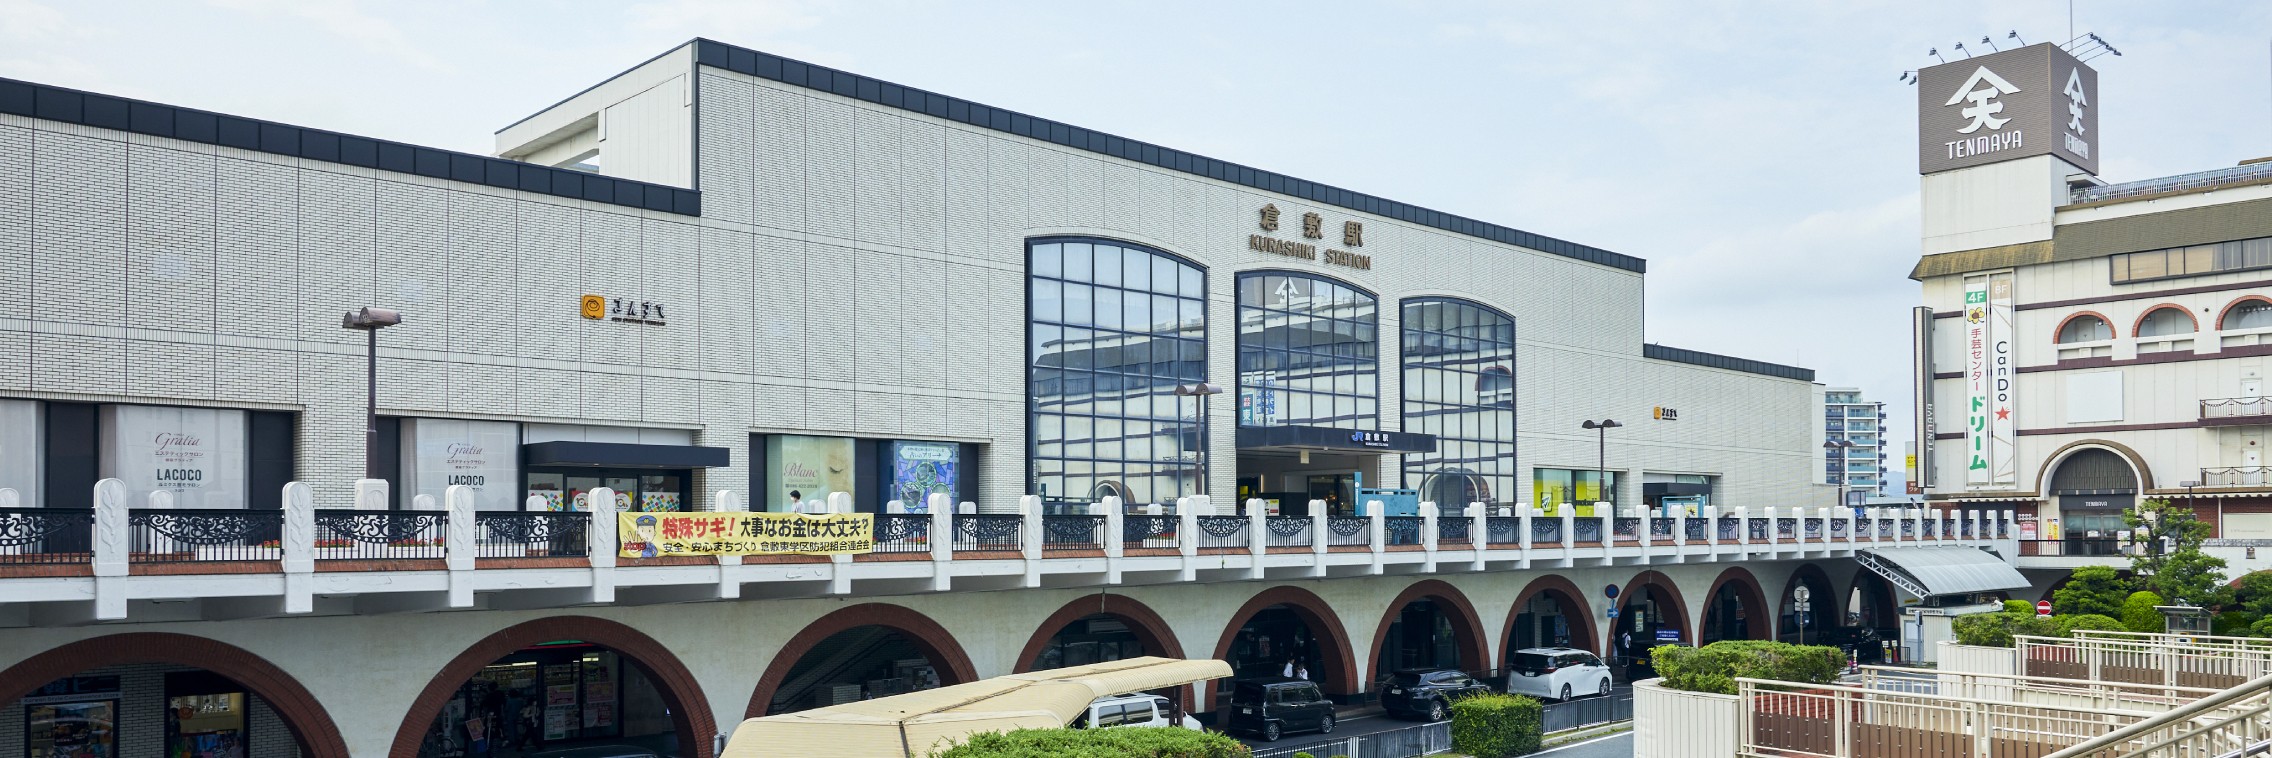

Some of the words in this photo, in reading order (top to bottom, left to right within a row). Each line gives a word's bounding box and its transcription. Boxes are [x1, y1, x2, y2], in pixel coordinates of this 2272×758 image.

[1945, 130, 2023, 160] TENMAYA
[2064, 132, 2089, 160] TENMAYA
[1259, 203, 1363, 247] 倉敷駅
[1249, 234, 1316, 260] KURASHIKI
[1325, 248, 1371, 270] STATION
[1968, 292, 1985, 303] 4F
[1971, 328, 1983, 391] 手芸センター
[1996, 340, 2009, 402] CanDo
[155, 432, 200, 450] Gratia
[1969, 396, 1988, 470] ドリーム
[157, 468, 202, 481] LACOCO
[448, 474, 485, 486] LACOCO
[783, 462, 818, 478] Blanc
[662, 517, 736, 540] 特殊サギ！
[740, 516, 869, 539] 大事なお金は大丈夫？
[760, 539, 871, 553] 倉敷東学区防犯組合連合会
